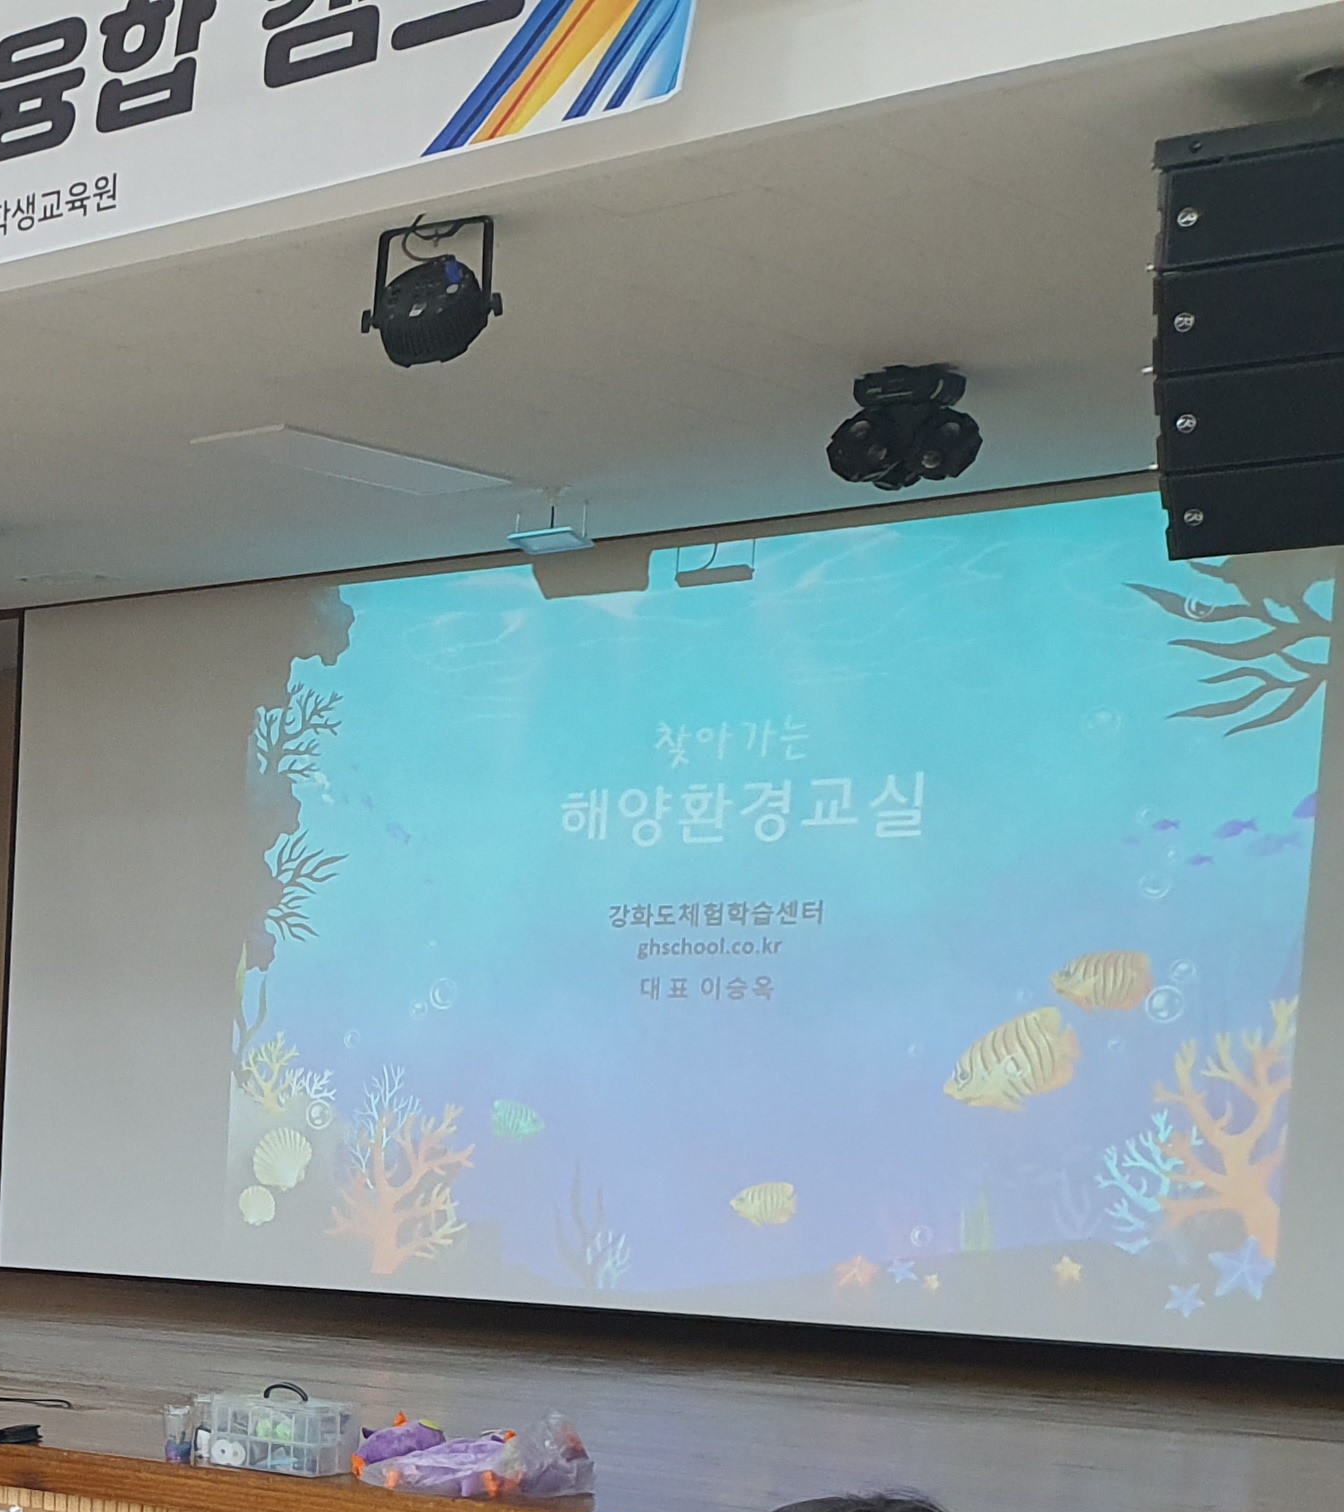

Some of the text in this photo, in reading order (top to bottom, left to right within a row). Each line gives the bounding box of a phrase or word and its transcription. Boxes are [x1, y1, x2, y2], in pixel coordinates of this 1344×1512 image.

[560, 771, 926, 848] 해양환경교실
[608, 899, 826, 929] 강화도체험학습센터
[636, 938, 783, 961] ghschool.co.kr
[639, 977, 689, 1002] 대표
